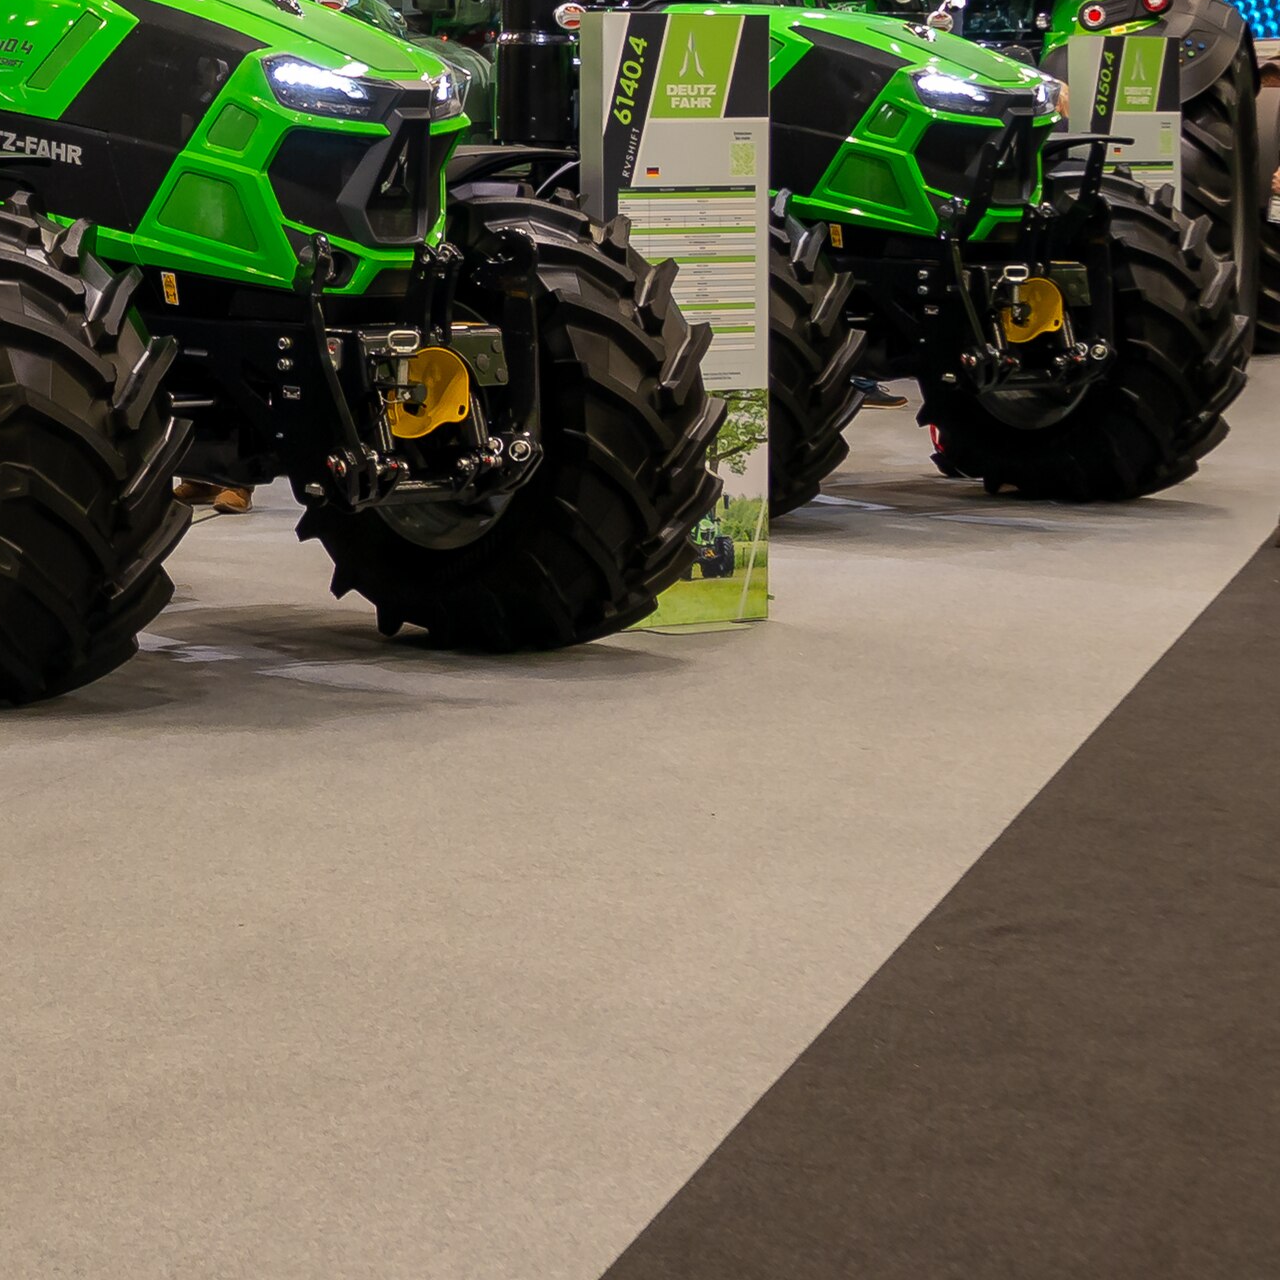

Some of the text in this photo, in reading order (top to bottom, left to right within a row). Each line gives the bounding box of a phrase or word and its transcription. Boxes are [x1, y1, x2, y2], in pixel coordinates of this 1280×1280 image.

[613, 35, 648, 125] 6140.4
[666, 84, 717, 96] DEUTZ
[671, 97, 712, 109] FAHR
[1095, 51, 1116, 116] 6150.4
[622, 127, 640, 178] RVSHIFT
